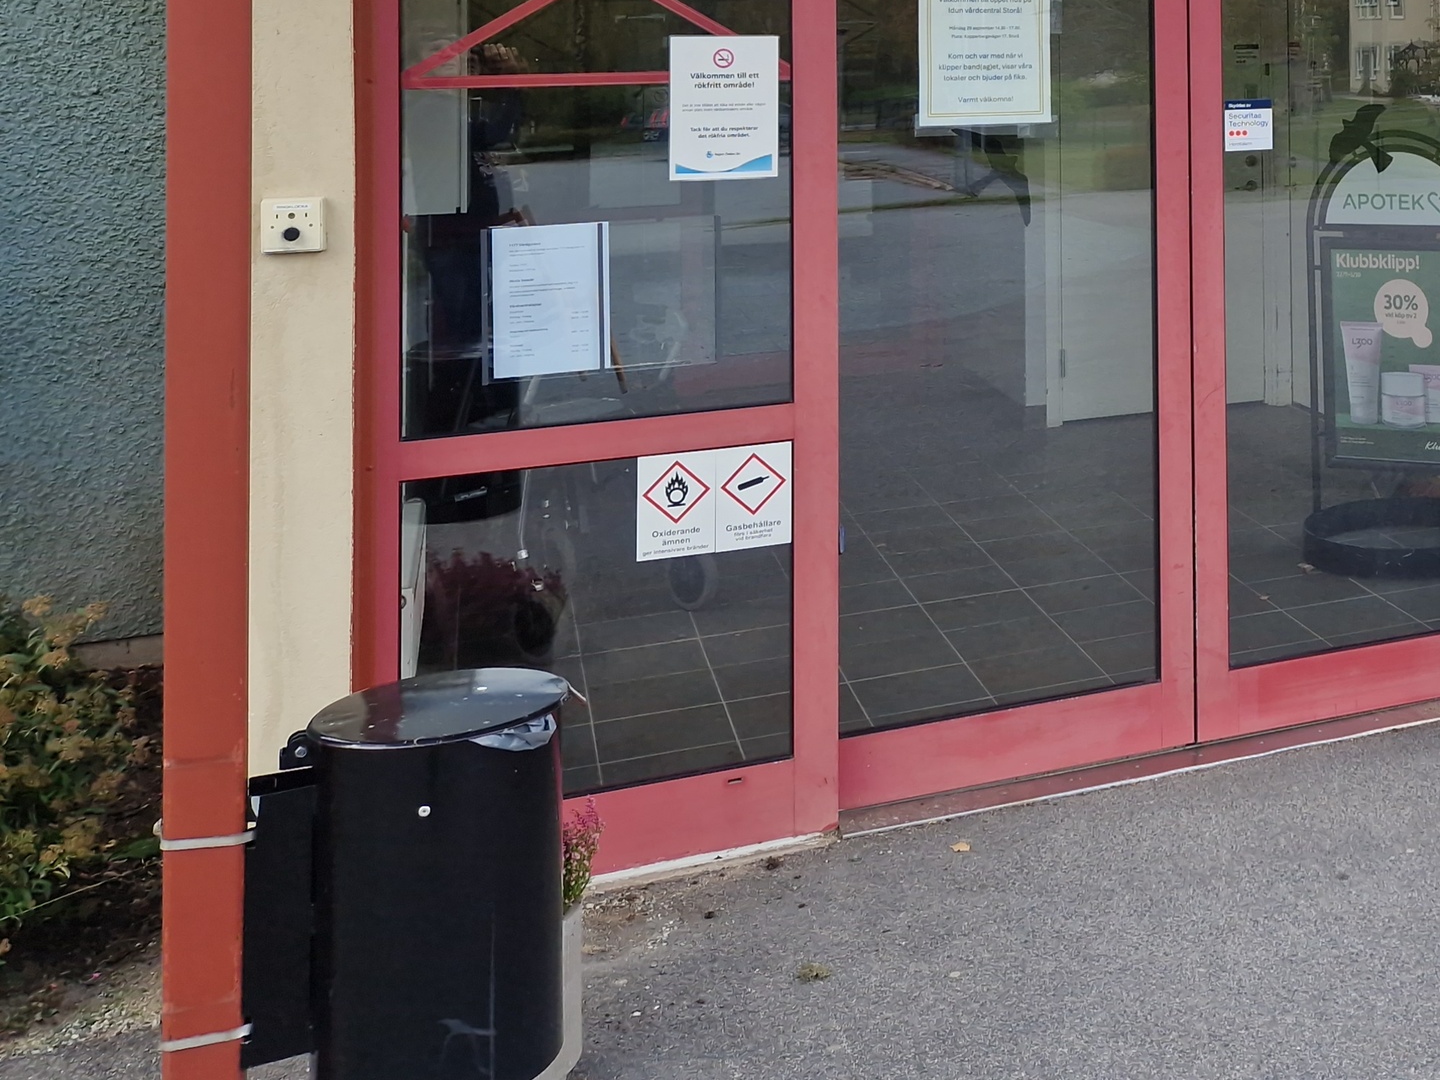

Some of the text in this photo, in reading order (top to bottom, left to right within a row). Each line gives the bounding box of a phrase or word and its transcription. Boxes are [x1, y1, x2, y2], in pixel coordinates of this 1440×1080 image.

[982, 74, 1003, 82] bjuder
[1343, 194, 1424, 210] APOTEK
[1336, 253, 1420, 272] Klubbklipp!
[1384, 294, 1418, 310] 30%
[1352, 338, 1372, 349] L300
[726, 520, 781, 532] Gasbehållare
[652, 527, 700, 538] Oxiderande
[662, 537, 690, 546] ämnen
